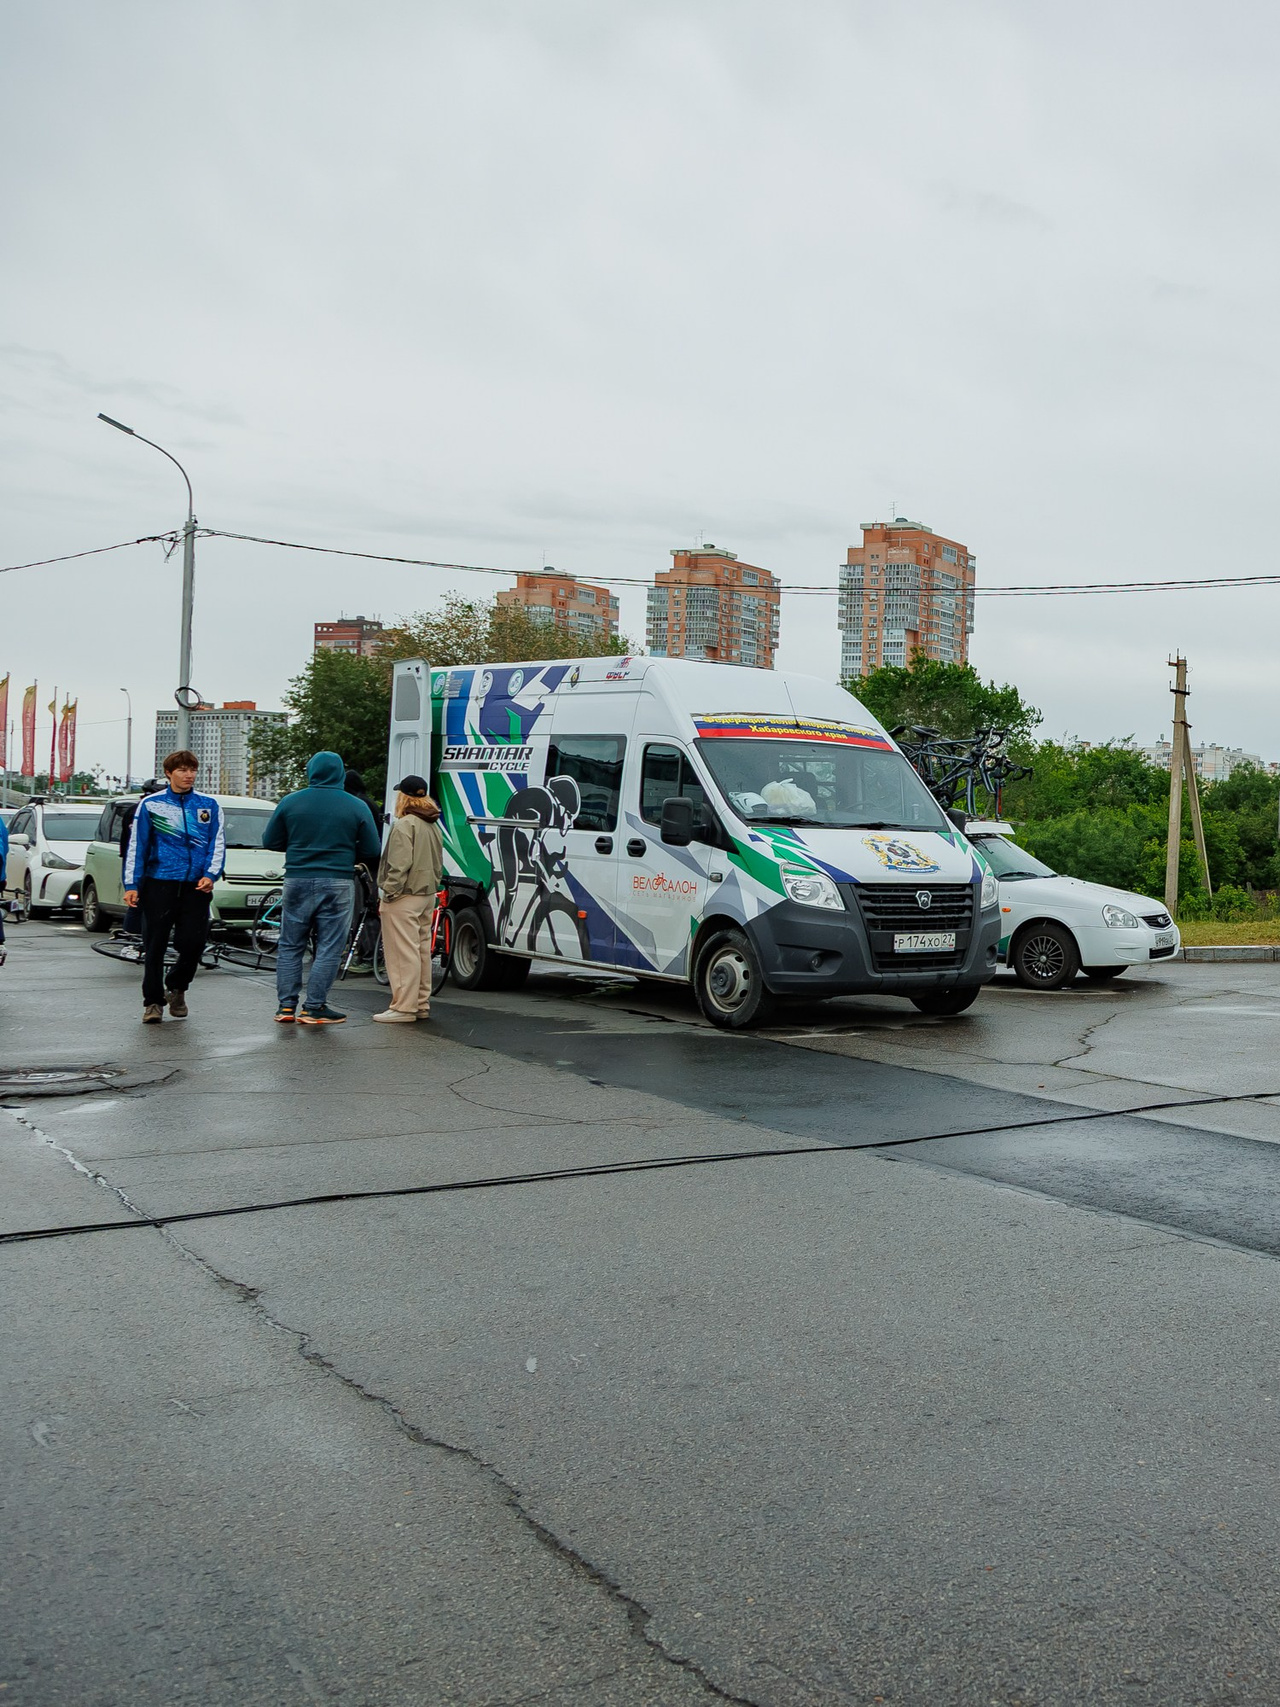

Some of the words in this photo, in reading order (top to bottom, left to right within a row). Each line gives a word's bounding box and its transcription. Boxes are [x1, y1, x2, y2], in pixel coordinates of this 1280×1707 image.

[749, 725, 822, 736] Хабаровского
[824, 732, 848, 740] края
[443, 747, 534, 760] SHANTAR
[489, 762, 530, 771] CYCLE
[633, 873, 697, 894] ВЕЛОСАЛОН
